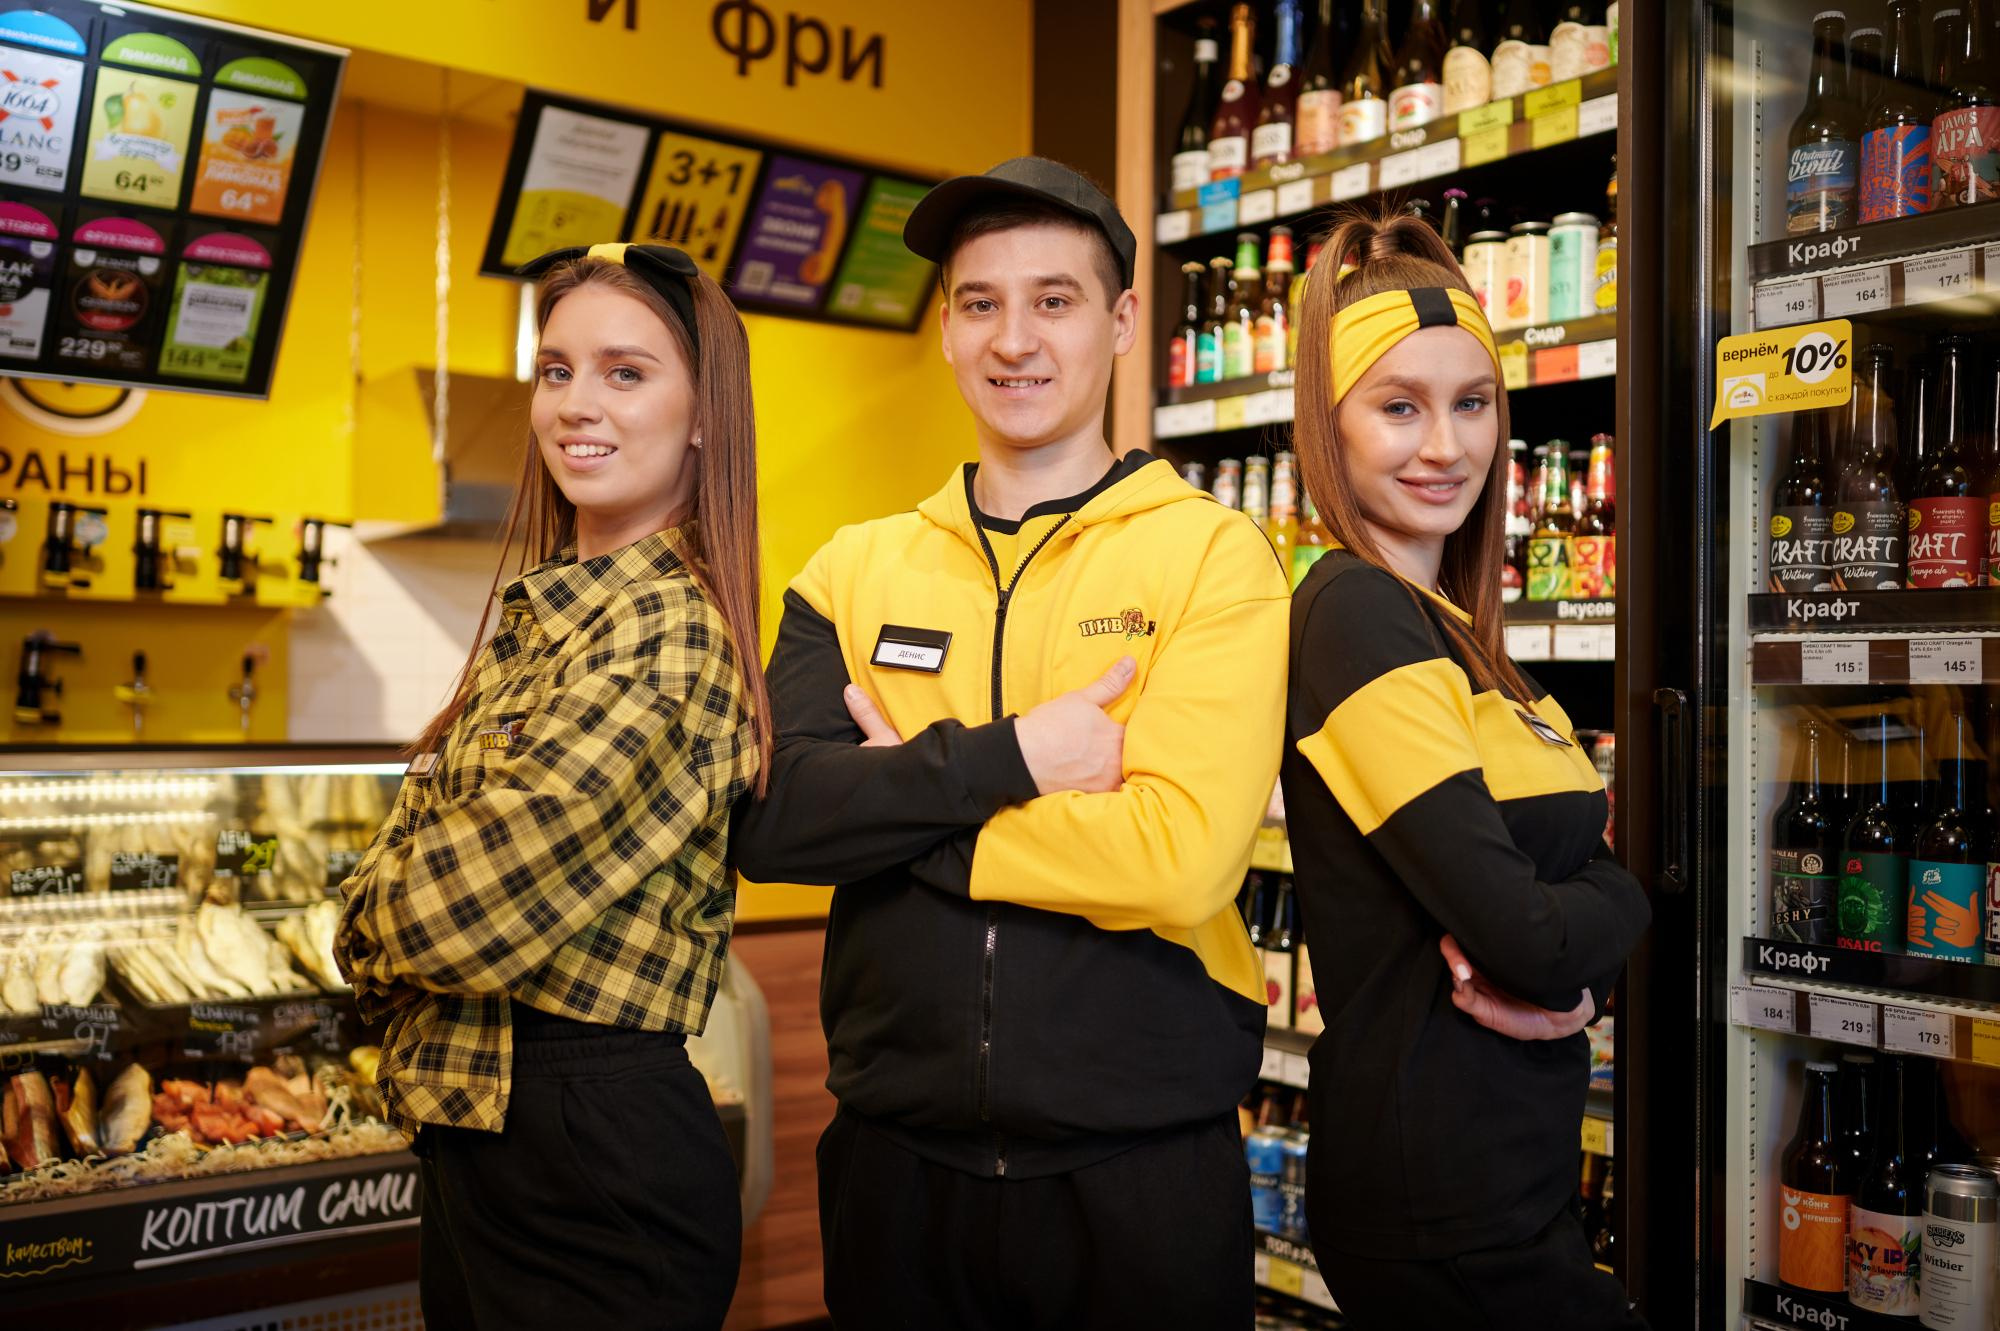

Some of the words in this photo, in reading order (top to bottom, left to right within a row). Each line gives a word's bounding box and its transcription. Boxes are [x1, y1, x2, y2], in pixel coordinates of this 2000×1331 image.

[711, 0, 884, 89] Фри
[1940, 111, 1978, 133] JAWS
[1936, 126, 1984, 156] APA
[115, 171, 147, 191] 64
[667, 150, 745, 197] 3+1
[220, 189, 252, 210] 64
[1788, 235, 1861, 265] Крафт
[1938, 273, 1961, 288] 174
[1856, 289, 1876, 302] 164
[1785, 300, 1805, 312] 149
[59, 336, 107, 360] 229
[1723, 342, 1778, 362] вернём
[1781, 339, 1848, 376] 10%
[1768, 371, 1780, 380] до
[1775, 391, 1809, 402] каждой
[1810, 386, 1848, 398] покупки
[1771, 539, 1834, 564] CRAFT
[1833, 535, 1899, 562] CRAFT
[1781, 568, 1815, 581] Witbier
[1844, 566, 1878, 579] Witbier
[1787, 598, 1860, 622] Крафт
[898, 650, 926, 662] ДЕНИС
[1944, 660, 1967, 672] 145
[1834, 661, 1855, 673] 115
[1759, 946, 1831, 974] Крафт
[1763, 1007, 1783, 1020] 184
[1841, 1019, 1864, 1033] 219
[1918, 1031, 1941, 1046] 179
[141, 1186, 306, 1251] КОПТИМ
[318, 1172, 417, 1225] САМИ
[1924, 1252, 1965, 1273] Witbier
[1776, 1294, 1849, 1331] Крафт
